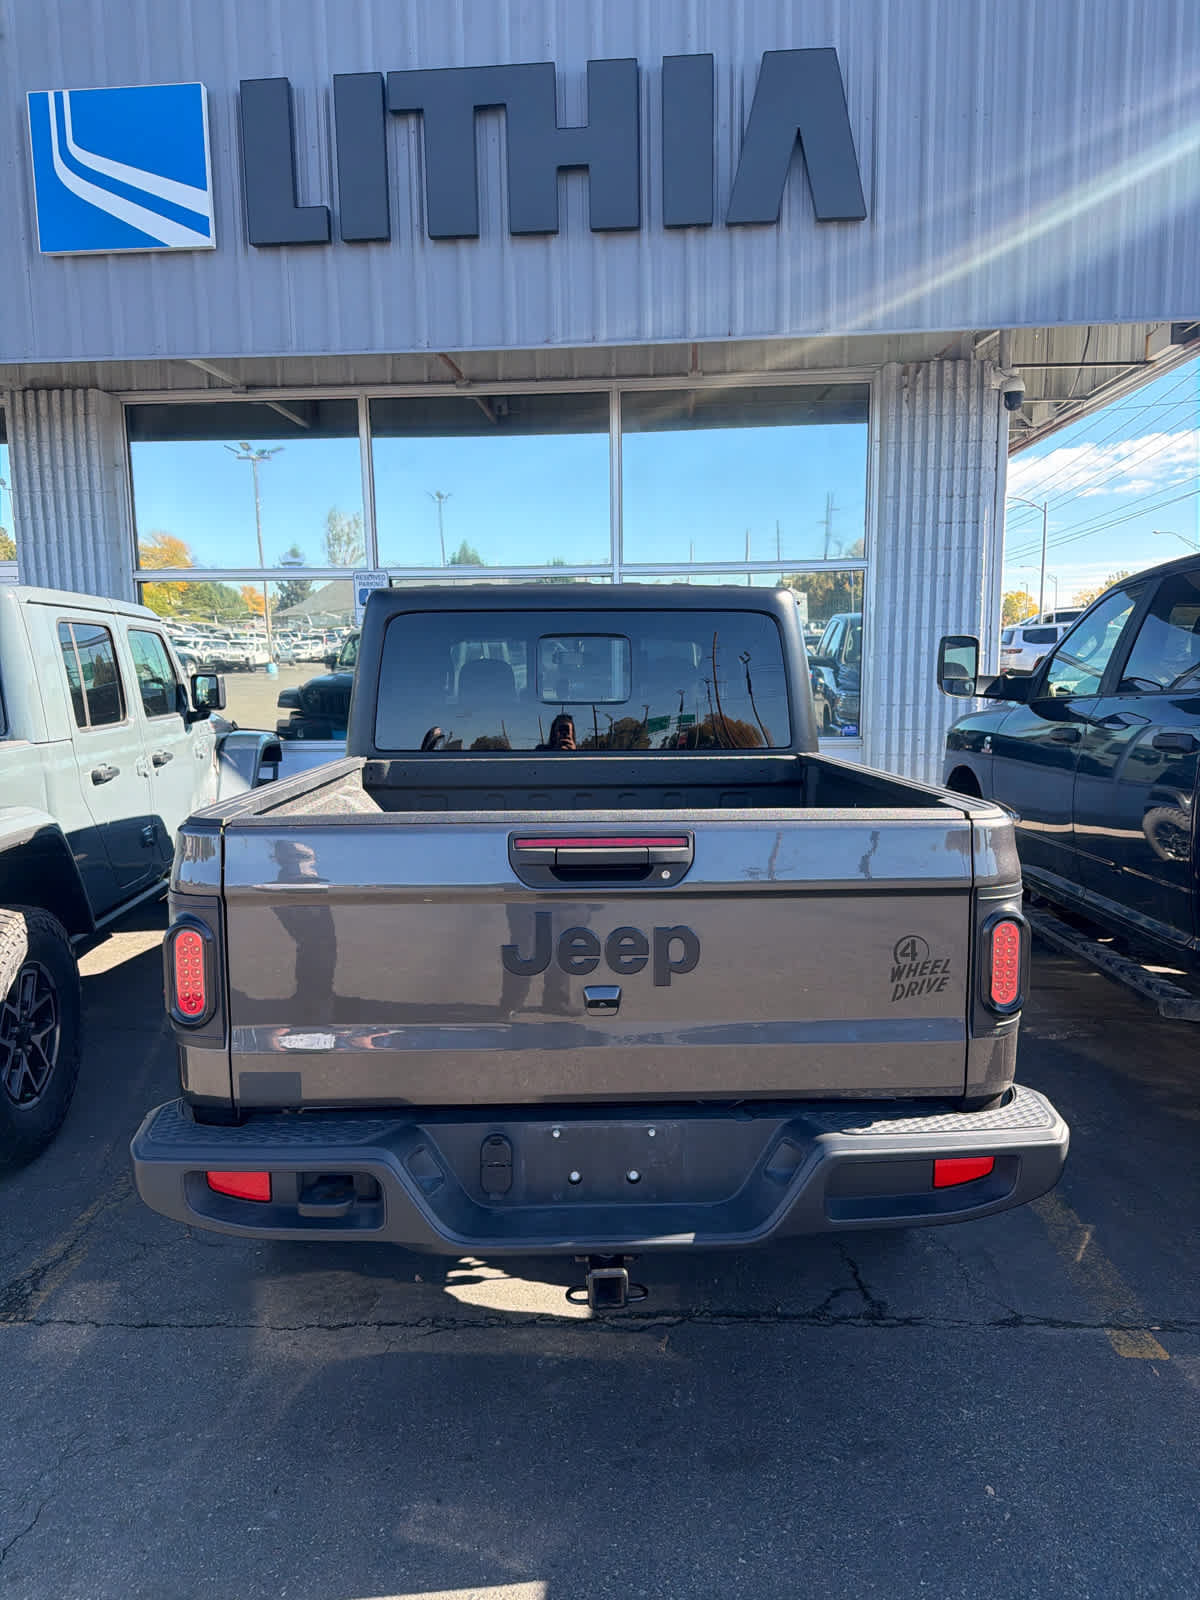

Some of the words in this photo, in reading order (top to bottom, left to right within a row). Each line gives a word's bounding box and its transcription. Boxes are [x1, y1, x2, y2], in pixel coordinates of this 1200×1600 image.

[239, 47, 867, 247] LITHIA
[501, 912, 701, 987] Jeep
[899, 939, 918, 961] 4
[890, 959, 951, 983] WHEEL
[891, 976, 950, 1002] DRIVE
